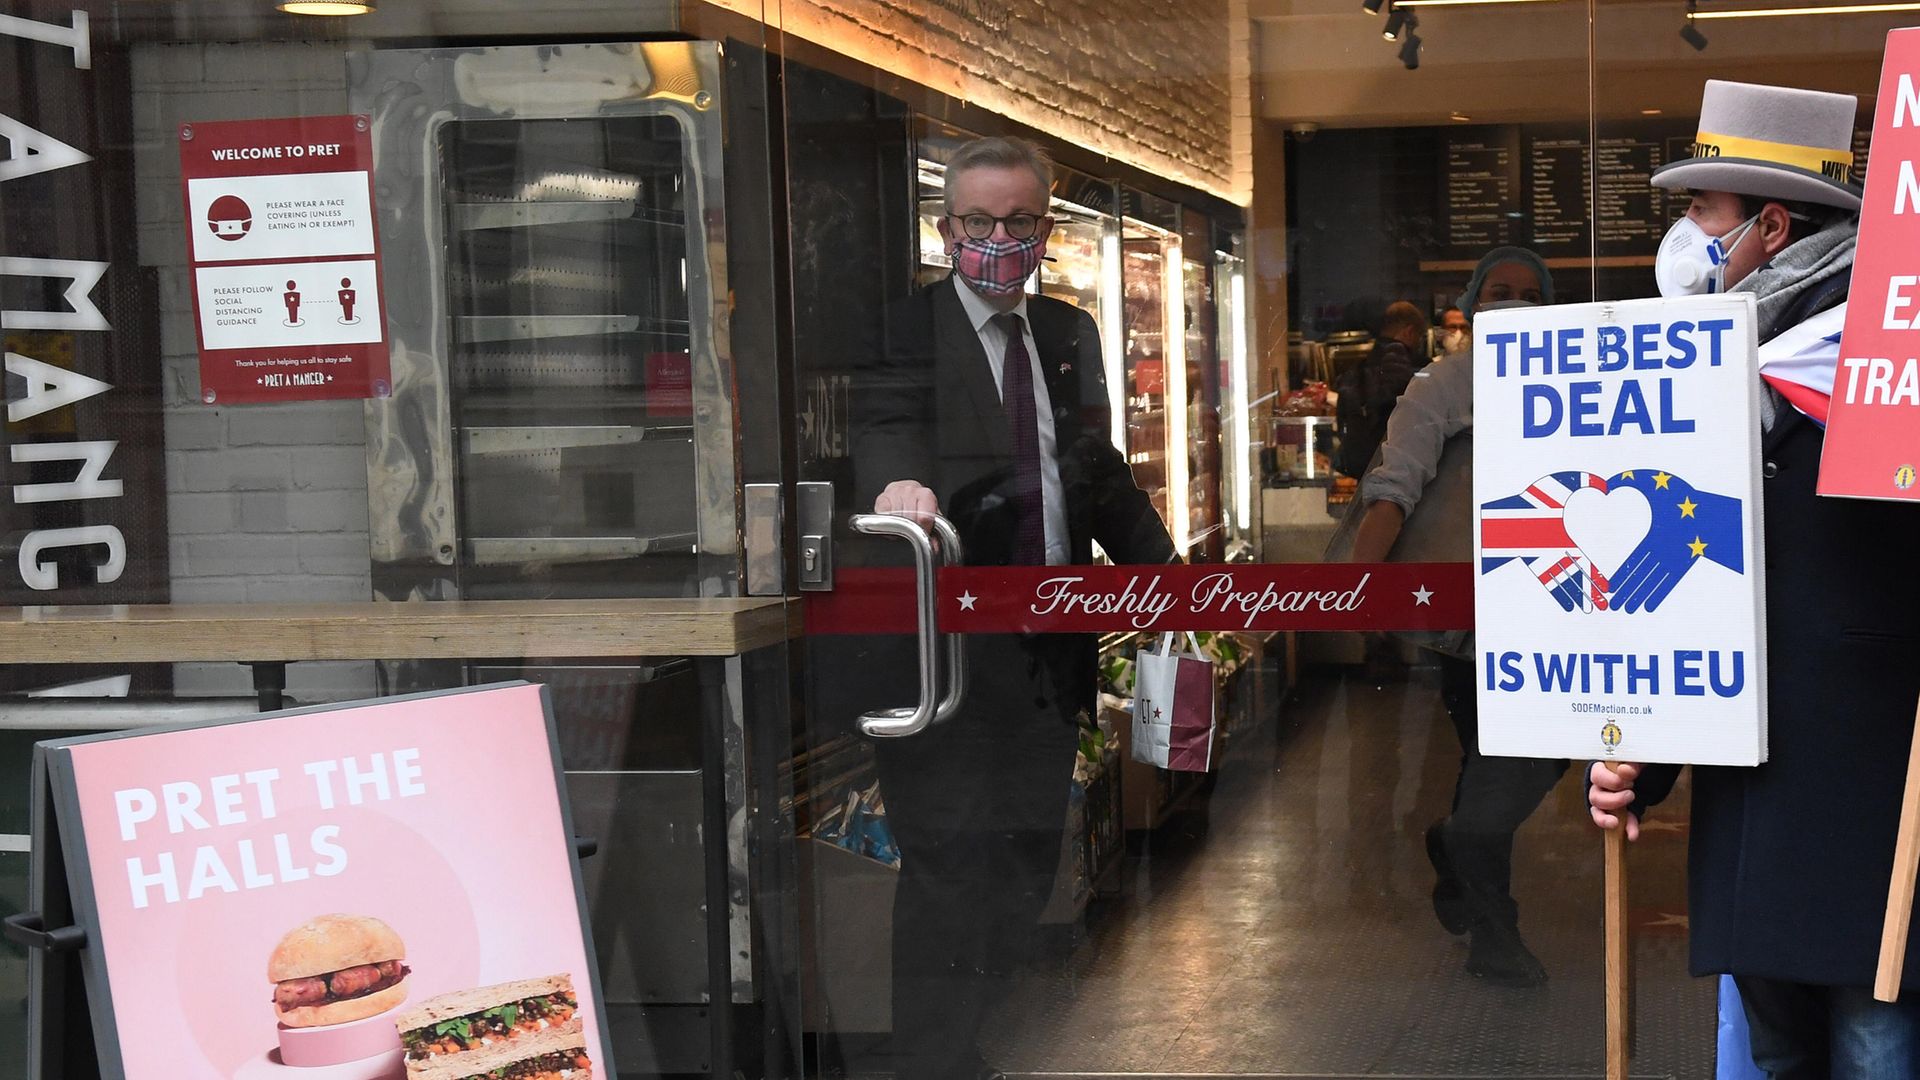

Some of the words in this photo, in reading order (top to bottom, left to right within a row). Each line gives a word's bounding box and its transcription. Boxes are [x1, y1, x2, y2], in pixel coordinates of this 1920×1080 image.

[212, 148, 282, 161] WELCOME
[285, 145, 304, 158] TO
[308, 144, 340, 156] PRET
[266, 201, 292, 209] PLEASE
[294, 200, 316, 208] WEAR
[267, 211, 307, 220] COVERING
[310, 210, 342, 219] (UNLESS
[268, 221, 296, 230] EATING
[297, 221, 307, 229] IN
[309, 220, 321, 228] OR
[323, 219, 355, 228] EXEMPT)
[213, 287, 240, 295] PLEASE
[242, 286, 273, 294] FOLLOW
[215, 307, 263, 316] DISTANCING
[216, 318, 257, 326] GUIDANCE
[1486, 329, 1586, 377] THE
[1598, 319, 1733, 371] BEST
[255, 360, 267, 368] you
[267, 358, 276, 366] for
[276, 357, 299, 367] helping
[325, 356, 337, 364] stay
[338, 355, 352, 363] safe
[264, 374, 283, 387] PRET
[285, 375, 291, 386] A
[293, 372, 325, 386] MANGER
[1523, 378, 1695, 438] DEAL
[0, 255, 131, 697] MANG
[1030, 575, 1178, 629] Freshly
[1190, 572, 1371, 629] Prepared
[1486, 652, 1524, 692] IS
[1534, 653, 1660, 695] WITH
[1674, 650, 1744, 697] EU
[1571, 703, 1653, 715] SODEMaction.co.uk
[115, 769, 280, 841] PRET
[304, 748, 426, 810] THE
[126, 826, 348, 909] HALLS
